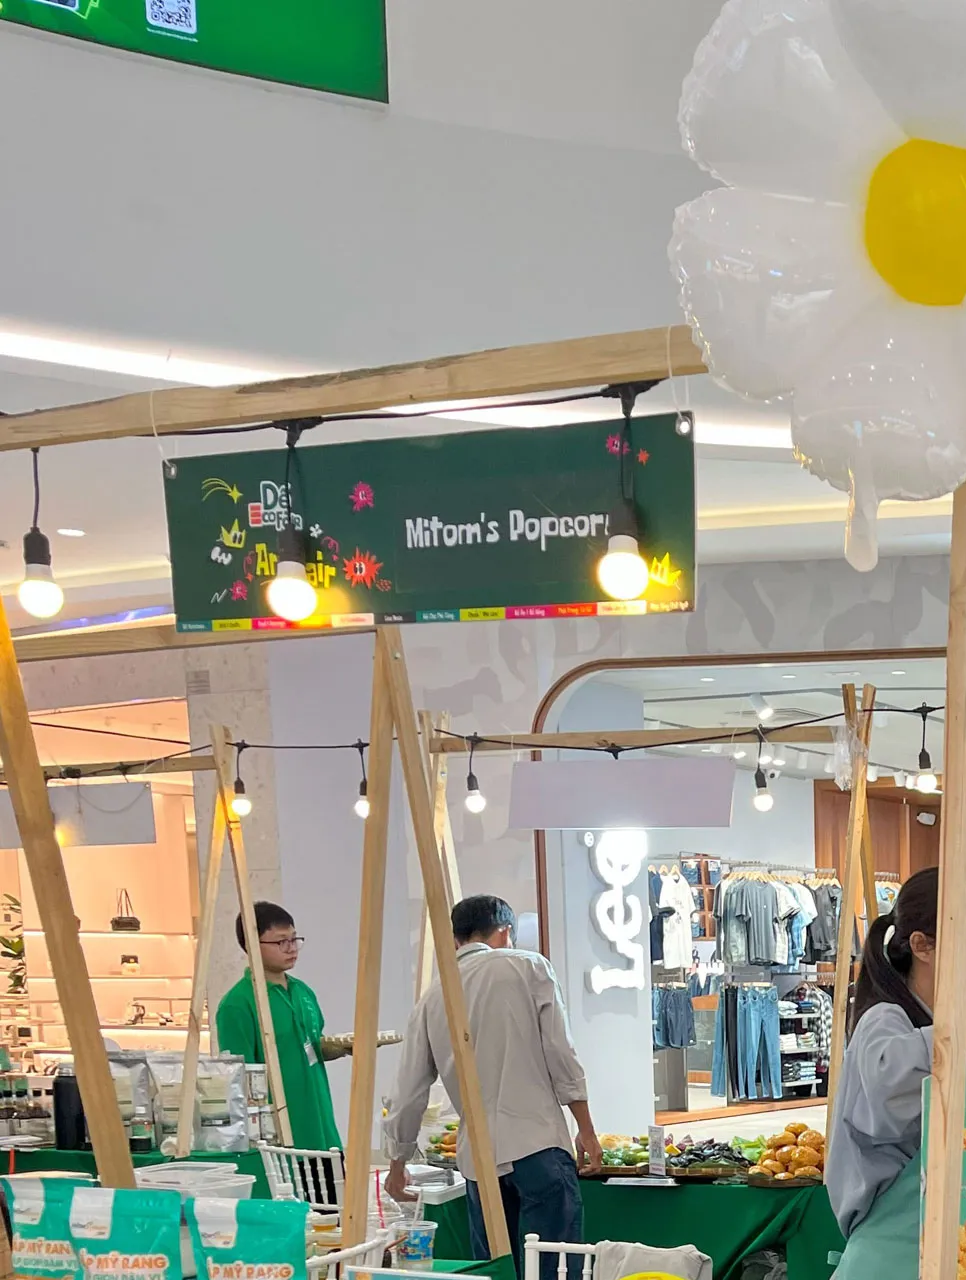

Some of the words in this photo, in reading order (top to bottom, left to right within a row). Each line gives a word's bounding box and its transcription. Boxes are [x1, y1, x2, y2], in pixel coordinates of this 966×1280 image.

[405, 512, 500, 549] Mitom's
[255, 543, 278, 576] Ar
[304, 550, 337, 589] air
[590, 829, 649, 995] Lee
[45, 1243, 71, 1255] RAN
[97, 1253, 118, 1269] MỸ
[122, 1256, 167, 1270] RANG
[223, 1263, 242, 1279] MỸ
